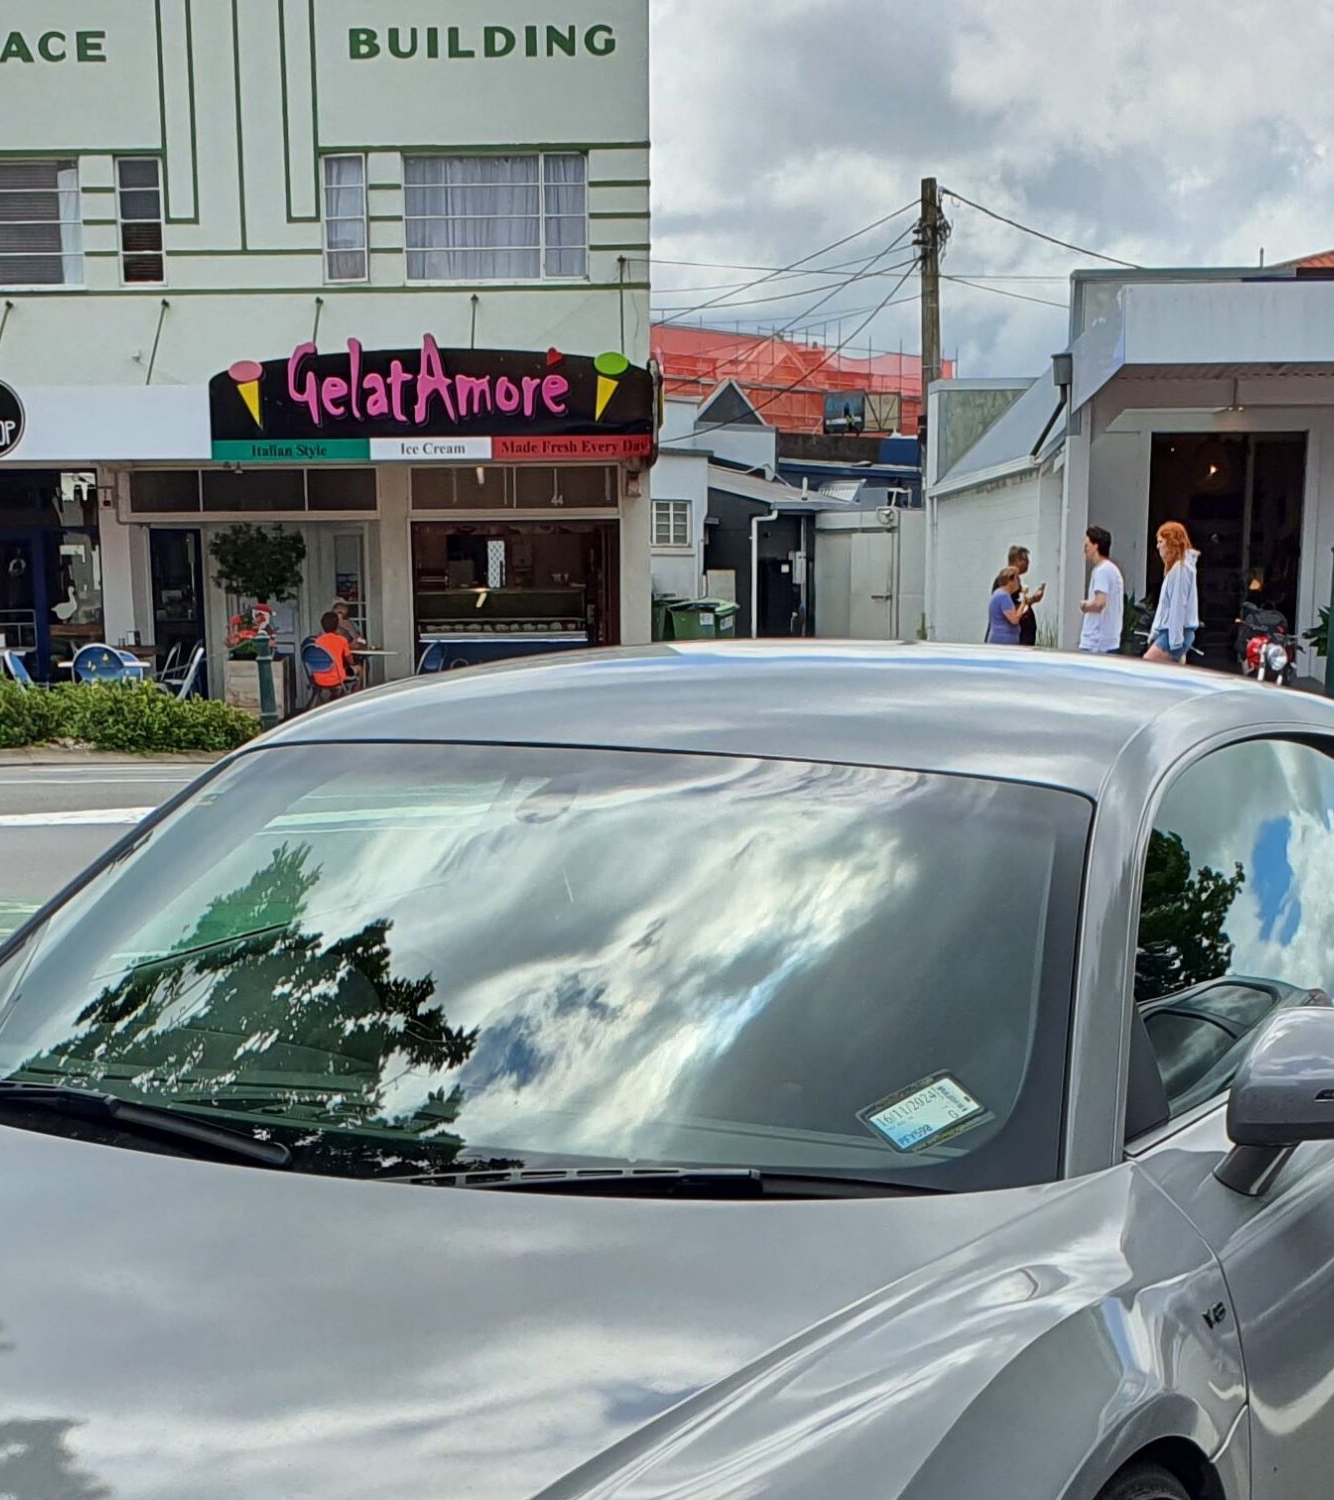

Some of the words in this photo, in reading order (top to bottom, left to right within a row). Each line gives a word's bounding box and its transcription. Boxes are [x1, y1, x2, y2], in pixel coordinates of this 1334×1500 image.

[348, 23, 617, 60] BUILDING
[251, 443, 293, 457] Italian
[297, 444, 328, 459] Style
[400, 442, 420, 455] Ice
[422, 442, 466, 455] Cream
[501, 441, 538, 454] Made
[542, 440, 578, 454] Fresh
[581, 439, 618, 456] Every
